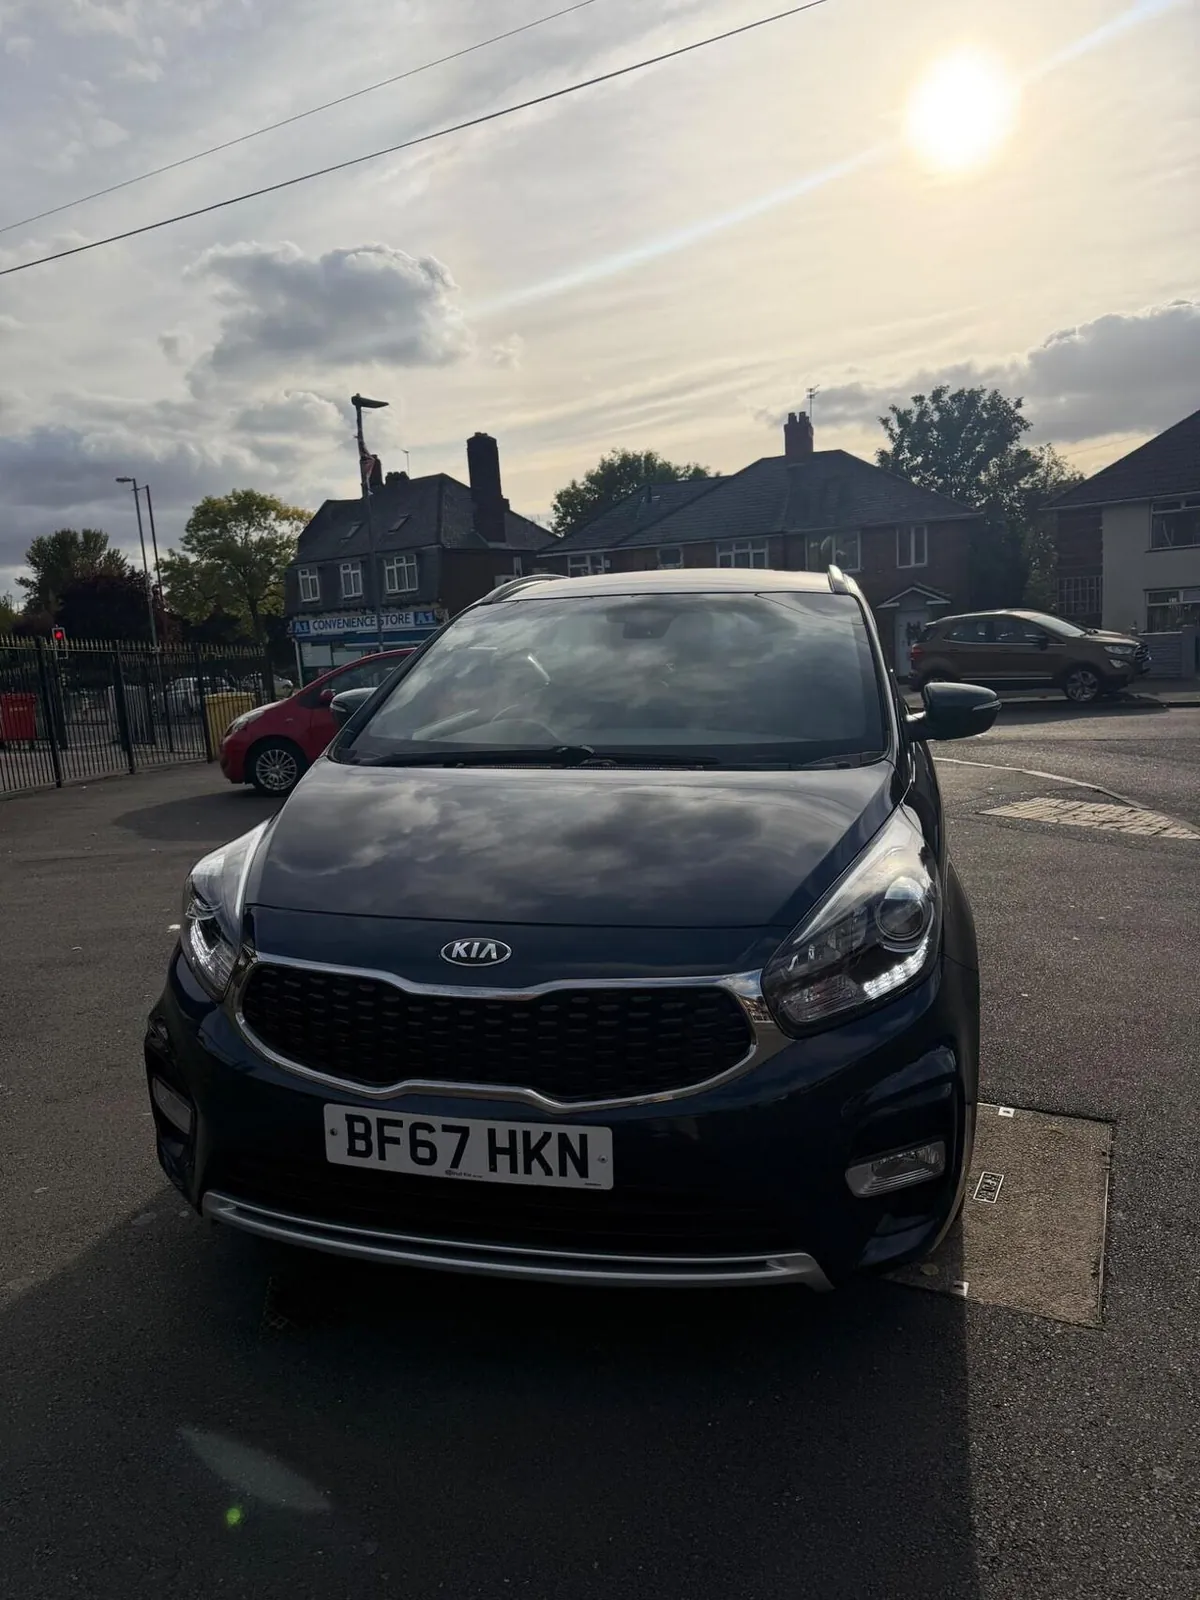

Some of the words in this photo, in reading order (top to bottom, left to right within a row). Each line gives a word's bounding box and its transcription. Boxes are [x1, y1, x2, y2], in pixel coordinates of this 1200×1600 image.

[295, 621, 308, 633] A1
[312, 615, 376, 631] CONVENIENCE
[380, 613, 411, 626] STORE
[416, 611, 434, 624] A1
[451, 942, 498, 960] KIA
[344, 1113, 471, 1169] BF67
[486, 1127, 590, 1179] HKN
